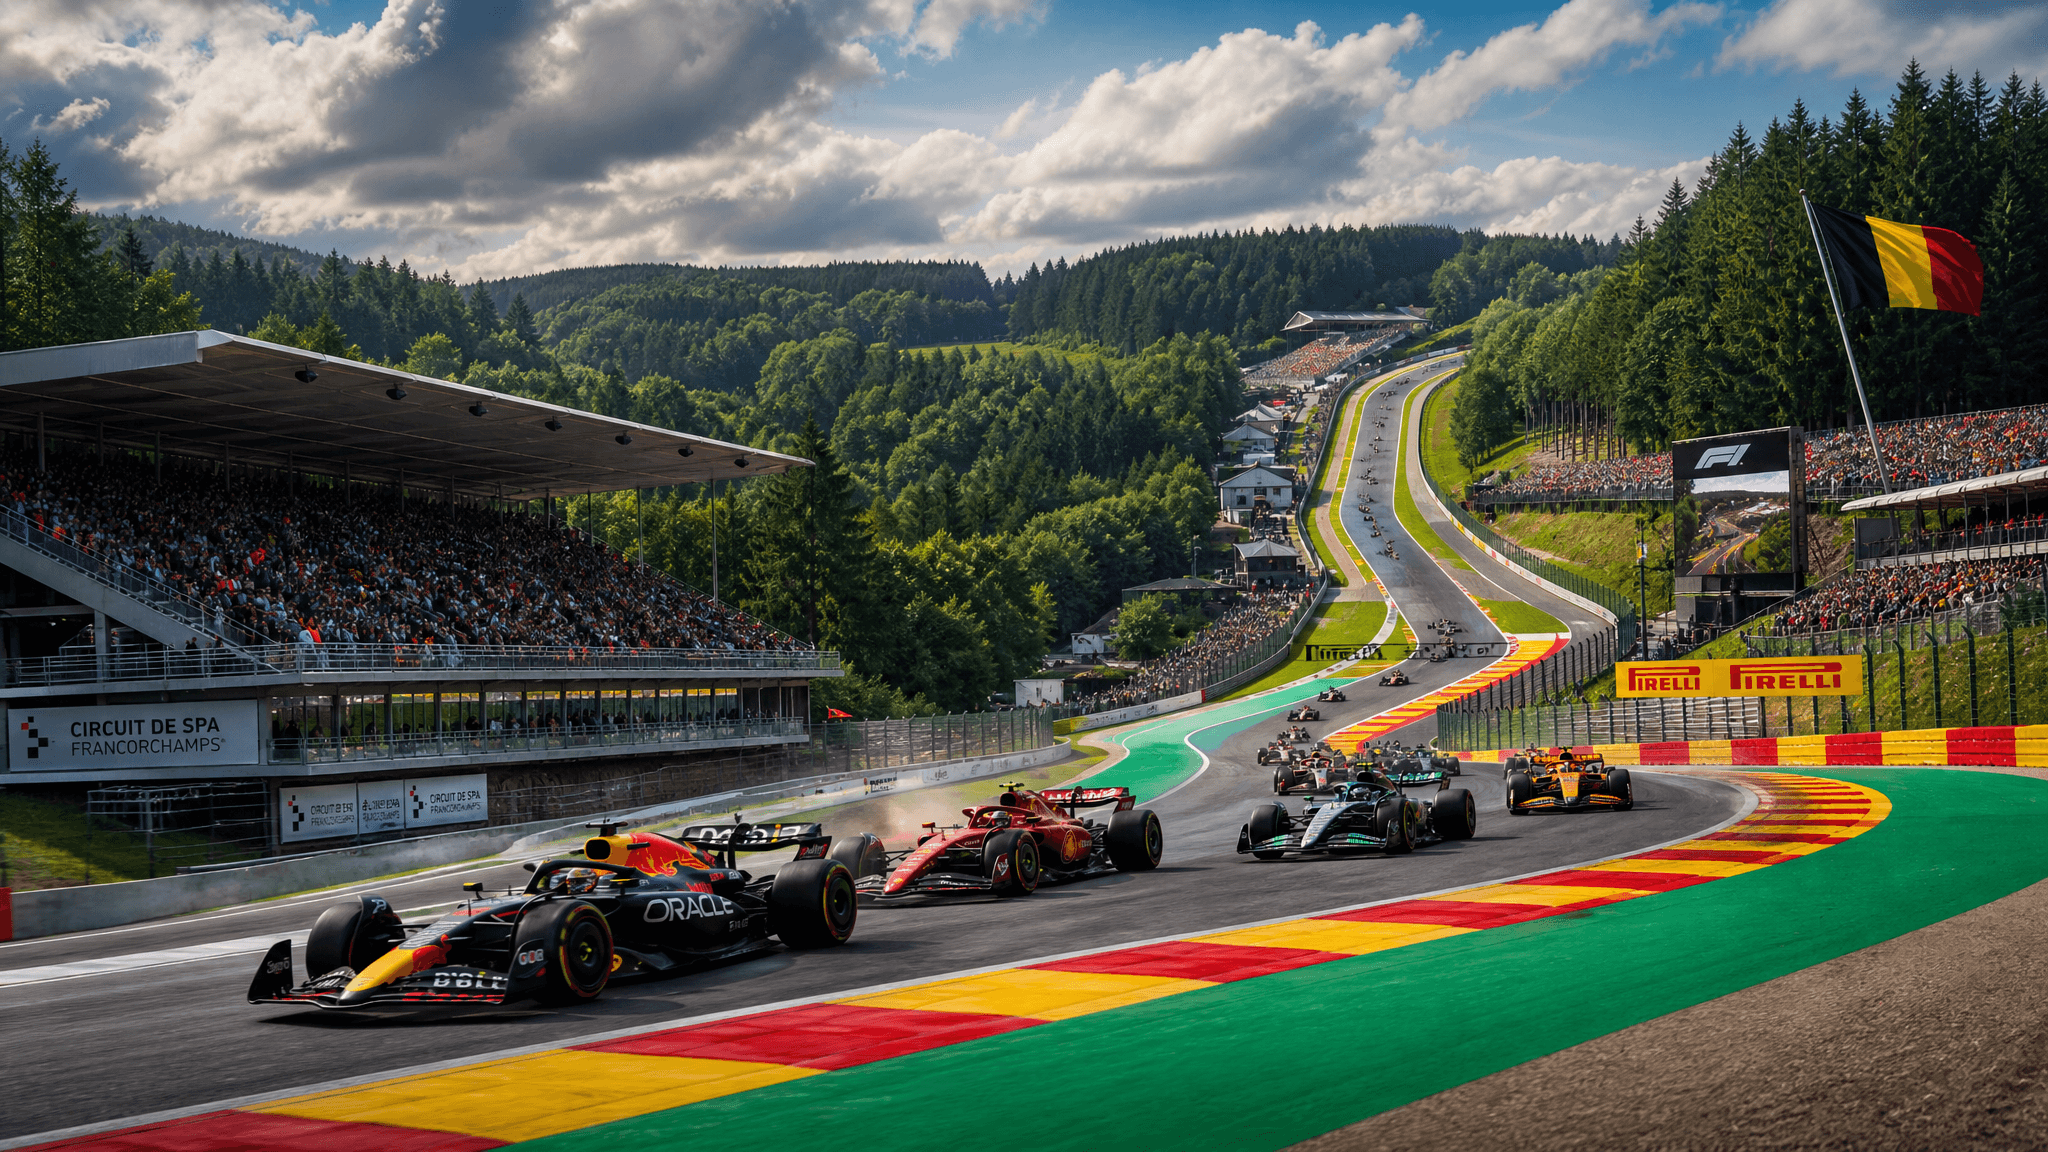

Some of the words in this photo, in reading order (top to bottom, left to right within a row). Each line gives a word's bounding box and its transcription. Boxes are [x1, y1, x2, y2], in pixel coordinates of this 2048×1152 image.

[1628, 666, 1700, 691] PIRELLI
[1729, 662, 1842, 690] PIRELLI
[70, 719, 145, 738] CIRCUIT
[151, 718, 177, 735] DE
[182, 717, 220, 734] SPA
[71, 737, 221, 756] FRANCORCHAMPS
[457, 791, 466, 802] DE
[467, 790, 481, 801] SPA
[643, 894, 734, 923] ORACLE
